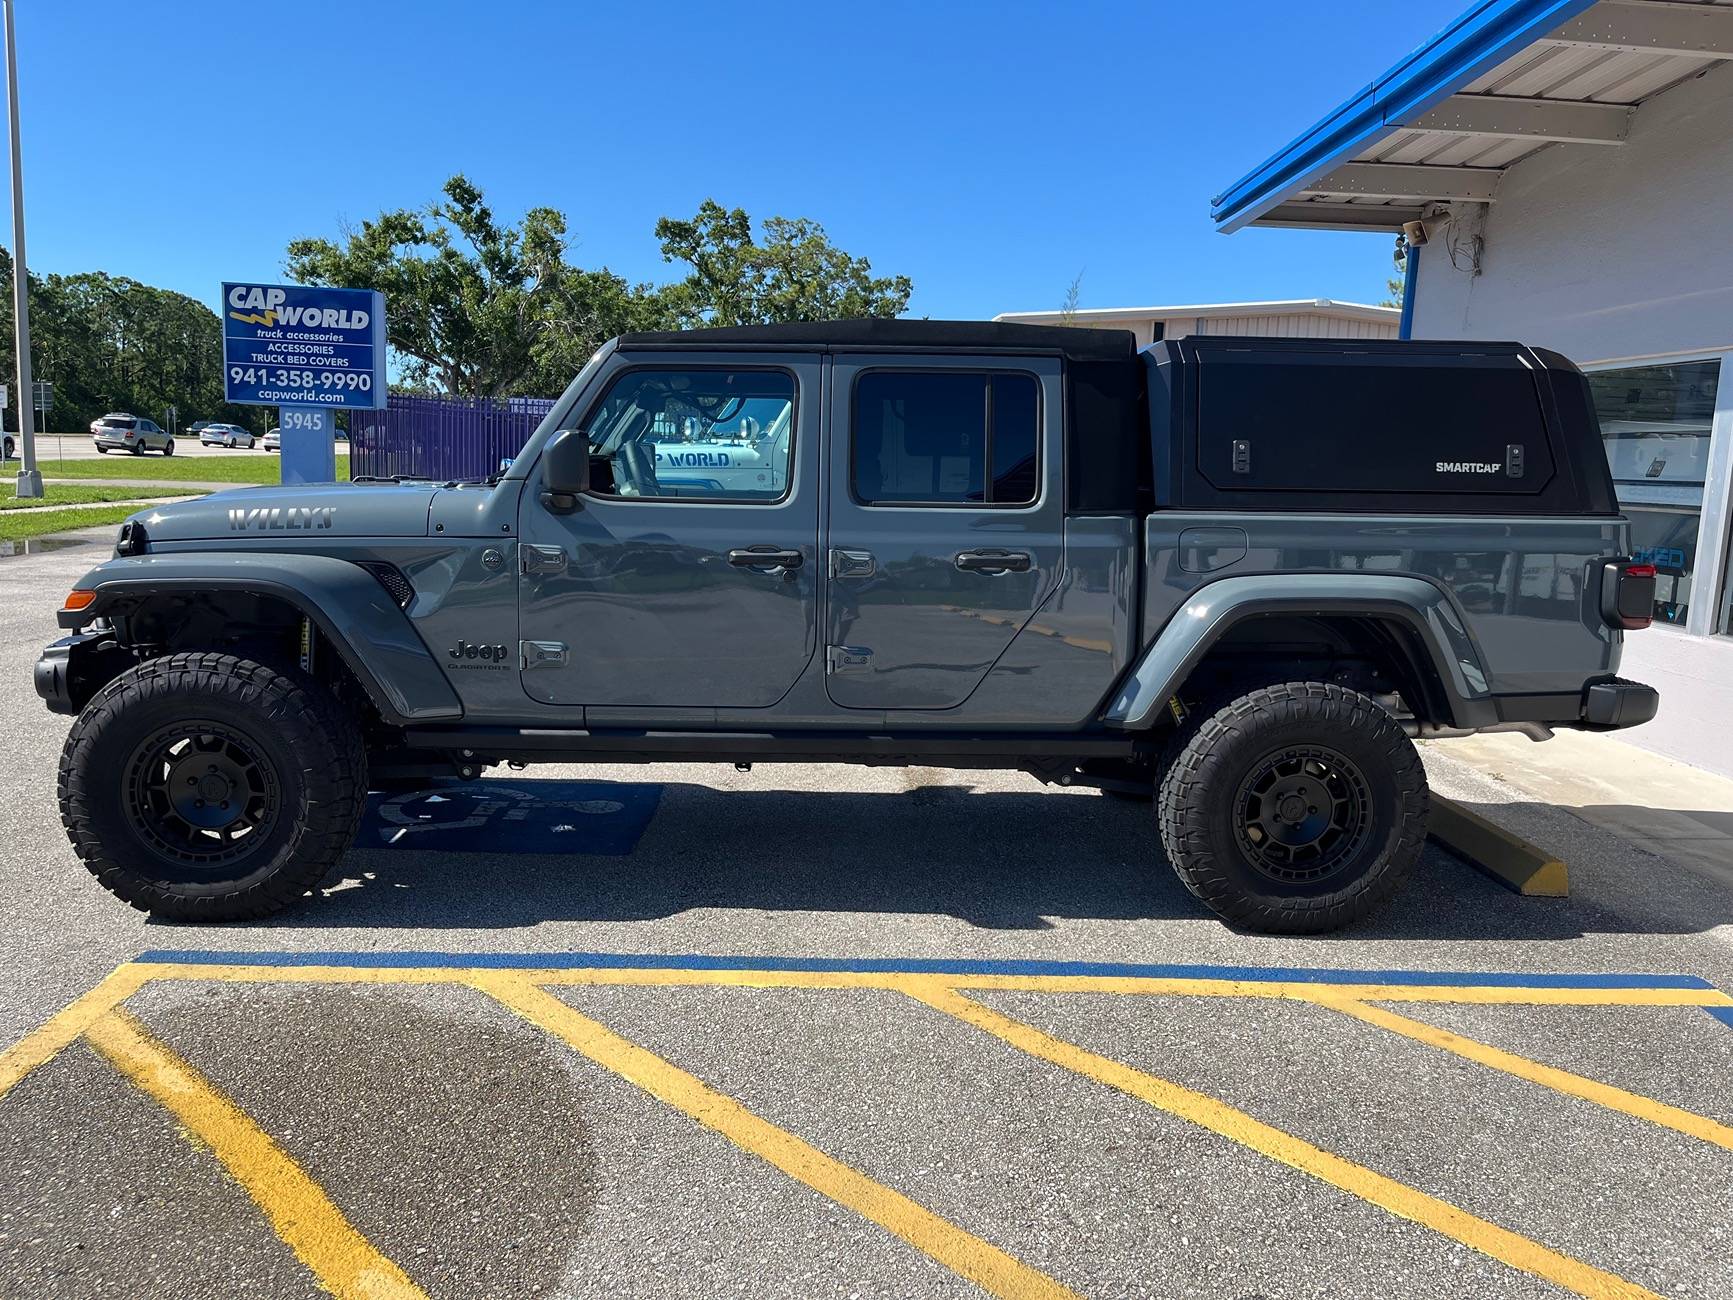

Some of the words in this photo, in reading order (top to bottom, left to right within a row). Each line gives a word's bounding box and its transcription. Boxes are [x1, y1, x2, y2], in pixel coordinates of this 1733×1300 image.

[229, 287, 286, 310] CAP
[276, 306, 370, 330] WORLD
[257, 329, 283, 339] truck
[286, 331, 344, 342] accessories
[267, 343, 334, 355] ACCESSORIES
[251, 353, 285, 363] TRUCK
[287, 356, 307, 364] BED
[309, 357, 349, 367] COVERS
[230, 367, 371, 391] 941-358-9990
[258, 390, 345, 403] capworld.com
[284, 412, 322, 430] 5945
[667, 453, 730, 467] WORLD
[1436, 462, 1501, 473] SMARTCAP
[449, 639, 508, 663] Jeep
